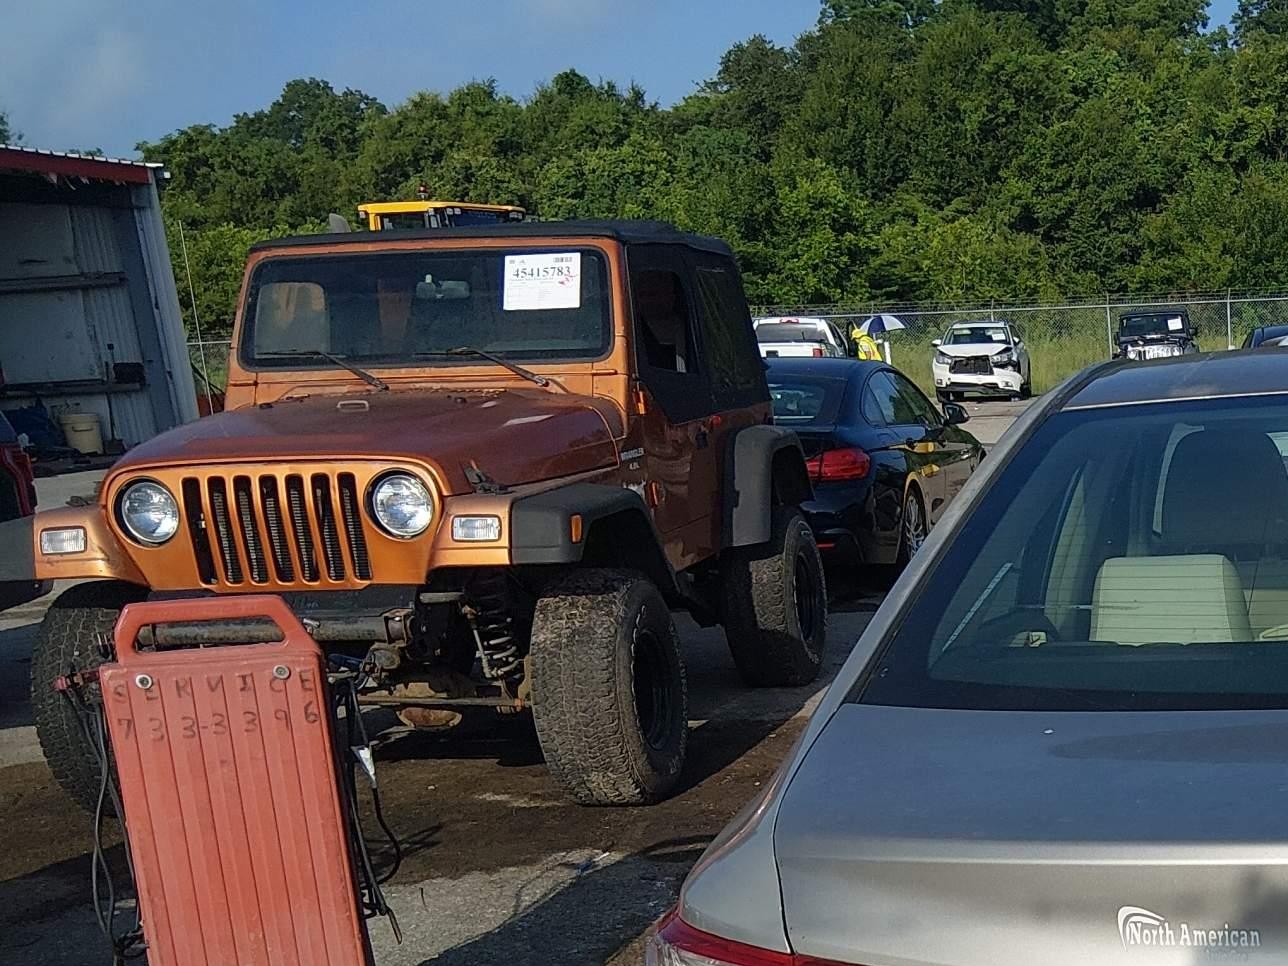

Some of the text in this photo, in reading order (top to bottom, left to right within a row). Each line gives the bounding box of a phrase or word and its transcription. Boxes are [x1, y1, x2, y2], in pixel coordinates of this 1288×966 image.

[512, 266, 571, 278] 45415783
[1129, 922, 1261, 946] North American
